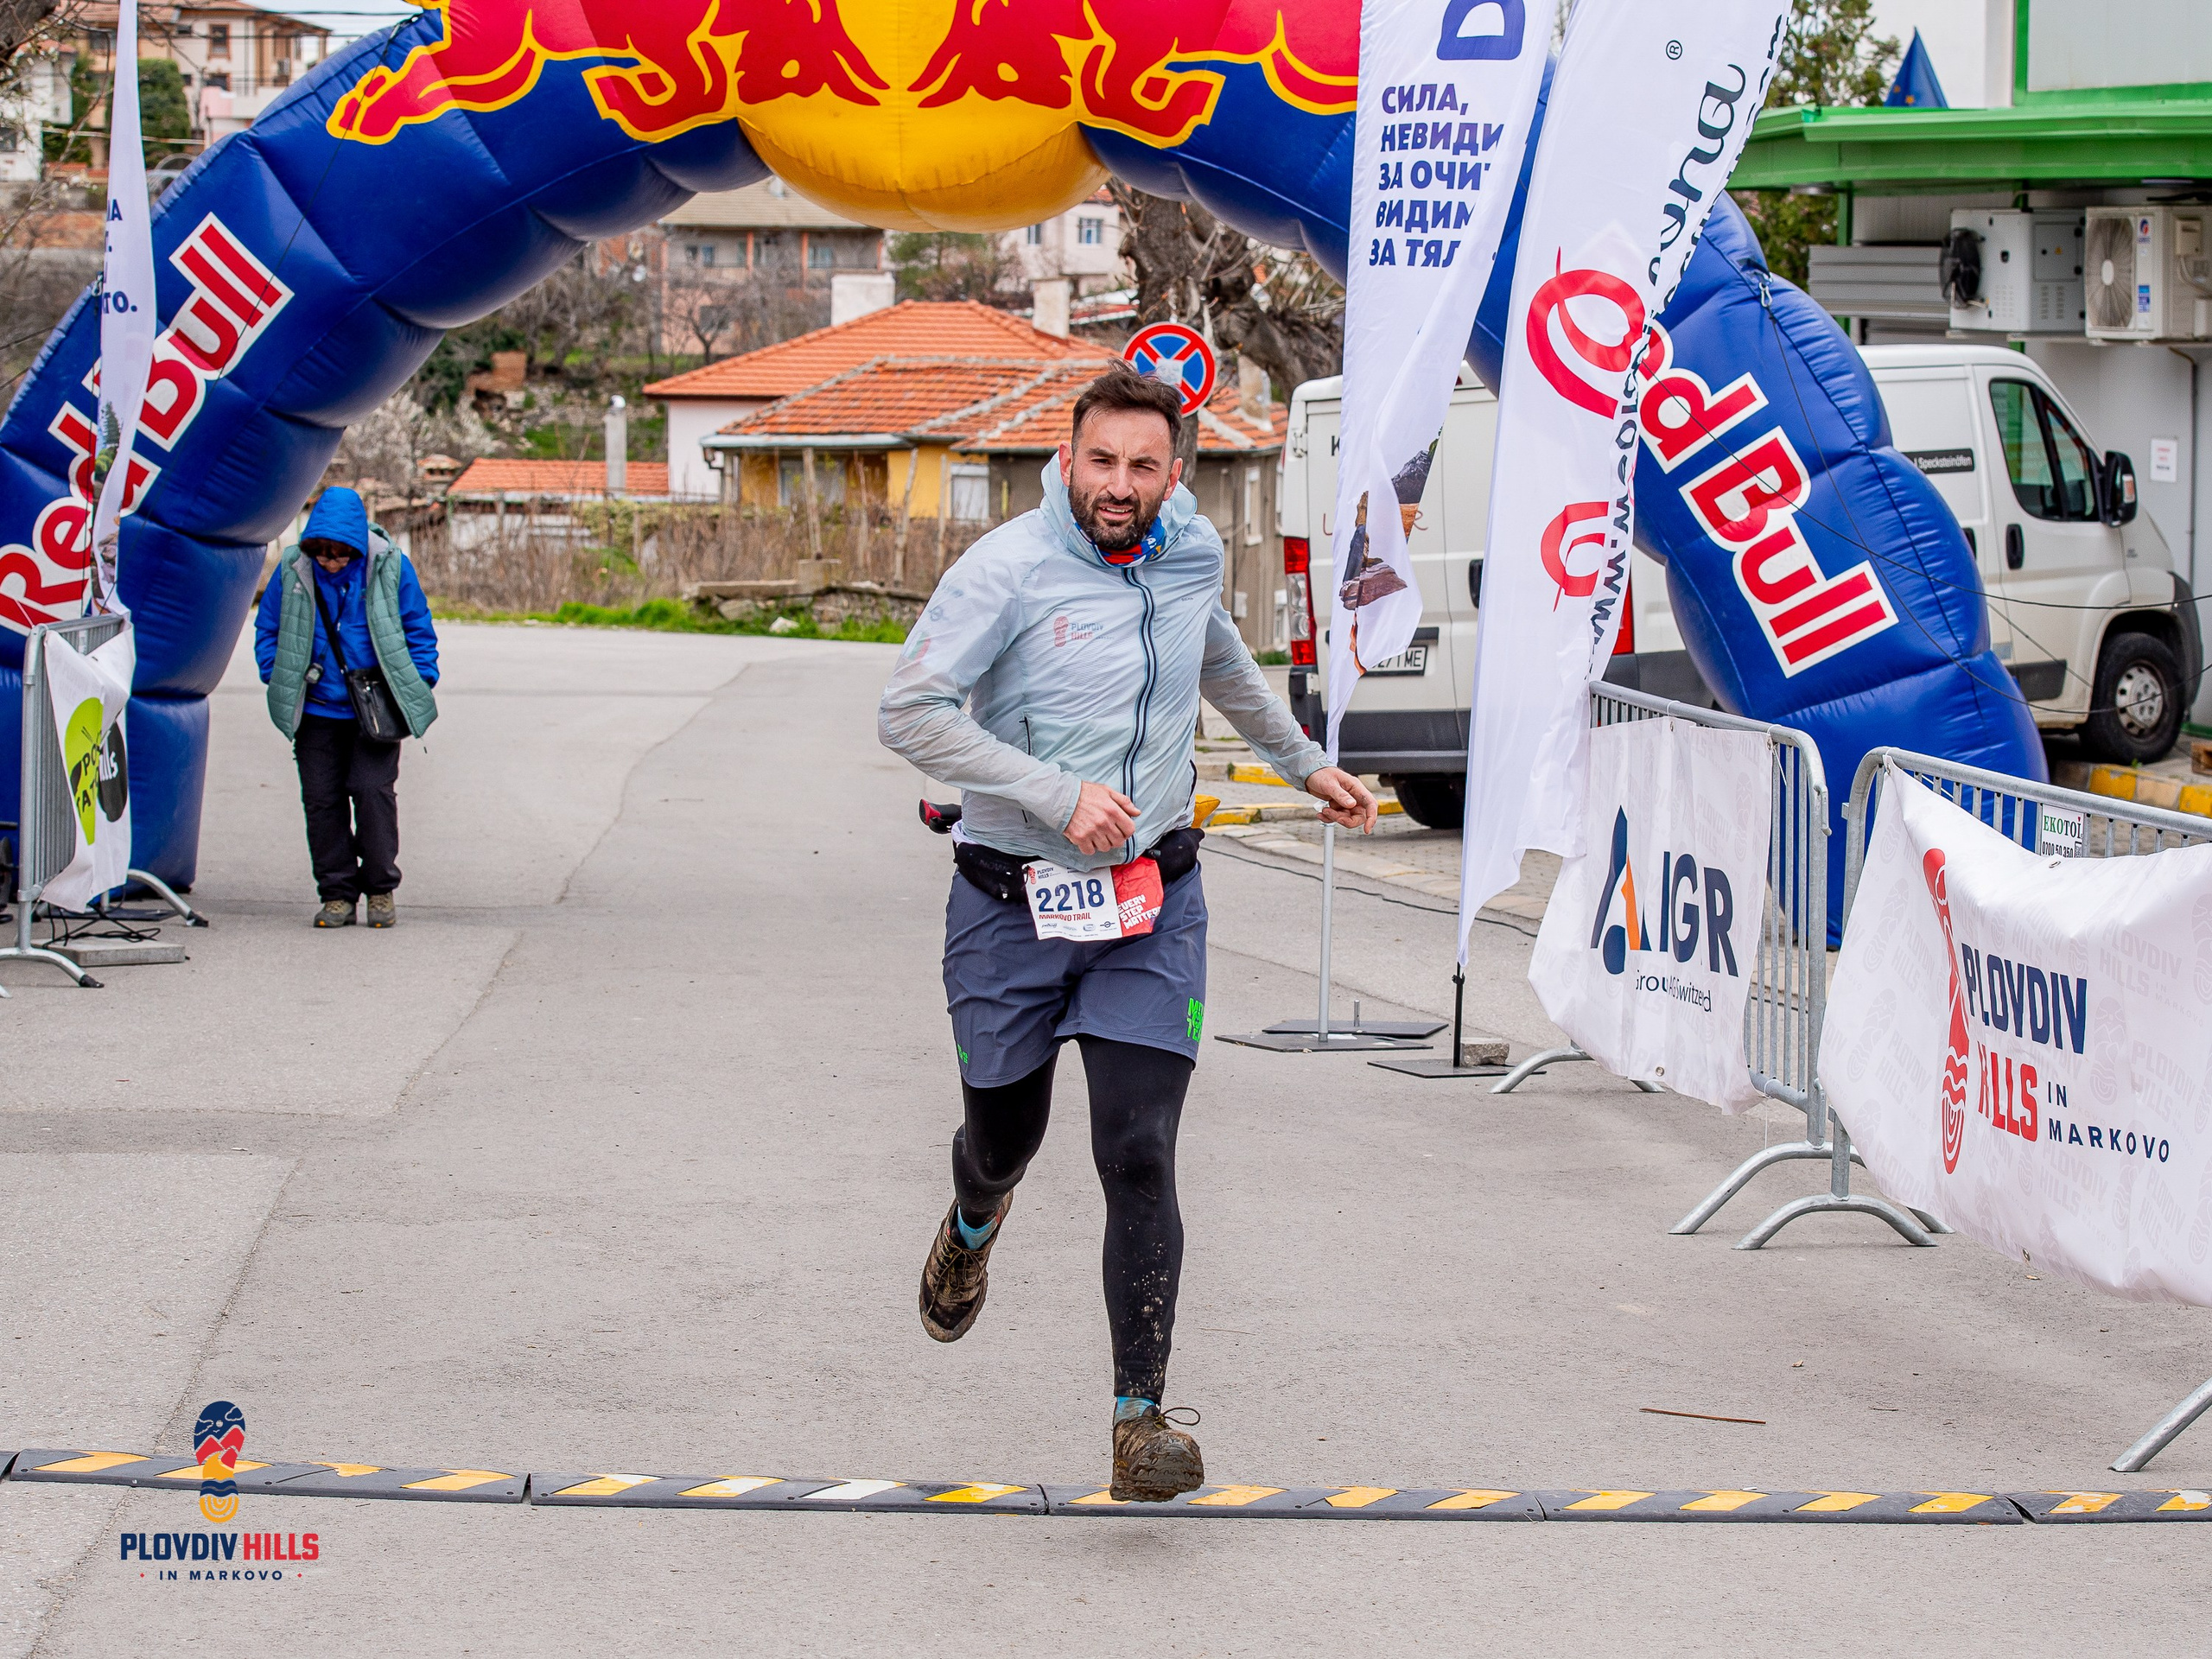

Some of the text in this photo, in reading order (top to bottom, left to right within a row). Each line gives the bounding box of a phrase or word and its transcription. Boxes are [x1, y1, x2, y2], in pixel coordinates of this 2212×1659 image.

[1382, 84, 1468, 115] СИЛА,
[1379, 162, 1403, 190] ЗА
[1369, 238, 1396, 266] ЗА
[1684, 431, 1893, 671] Bull
[1036, 879, 1104, 912] 2218
[1039, 912, 1091, 922] MARKOVO TRAIL
[1961, 943, 2088, 1055] PLOVDIV
[1977, 1040, 2037, 1142] HLLS
[2048, 1081, 2068, 1108] IN
[2049, 1117, 2170, 1163] MARKOVO
